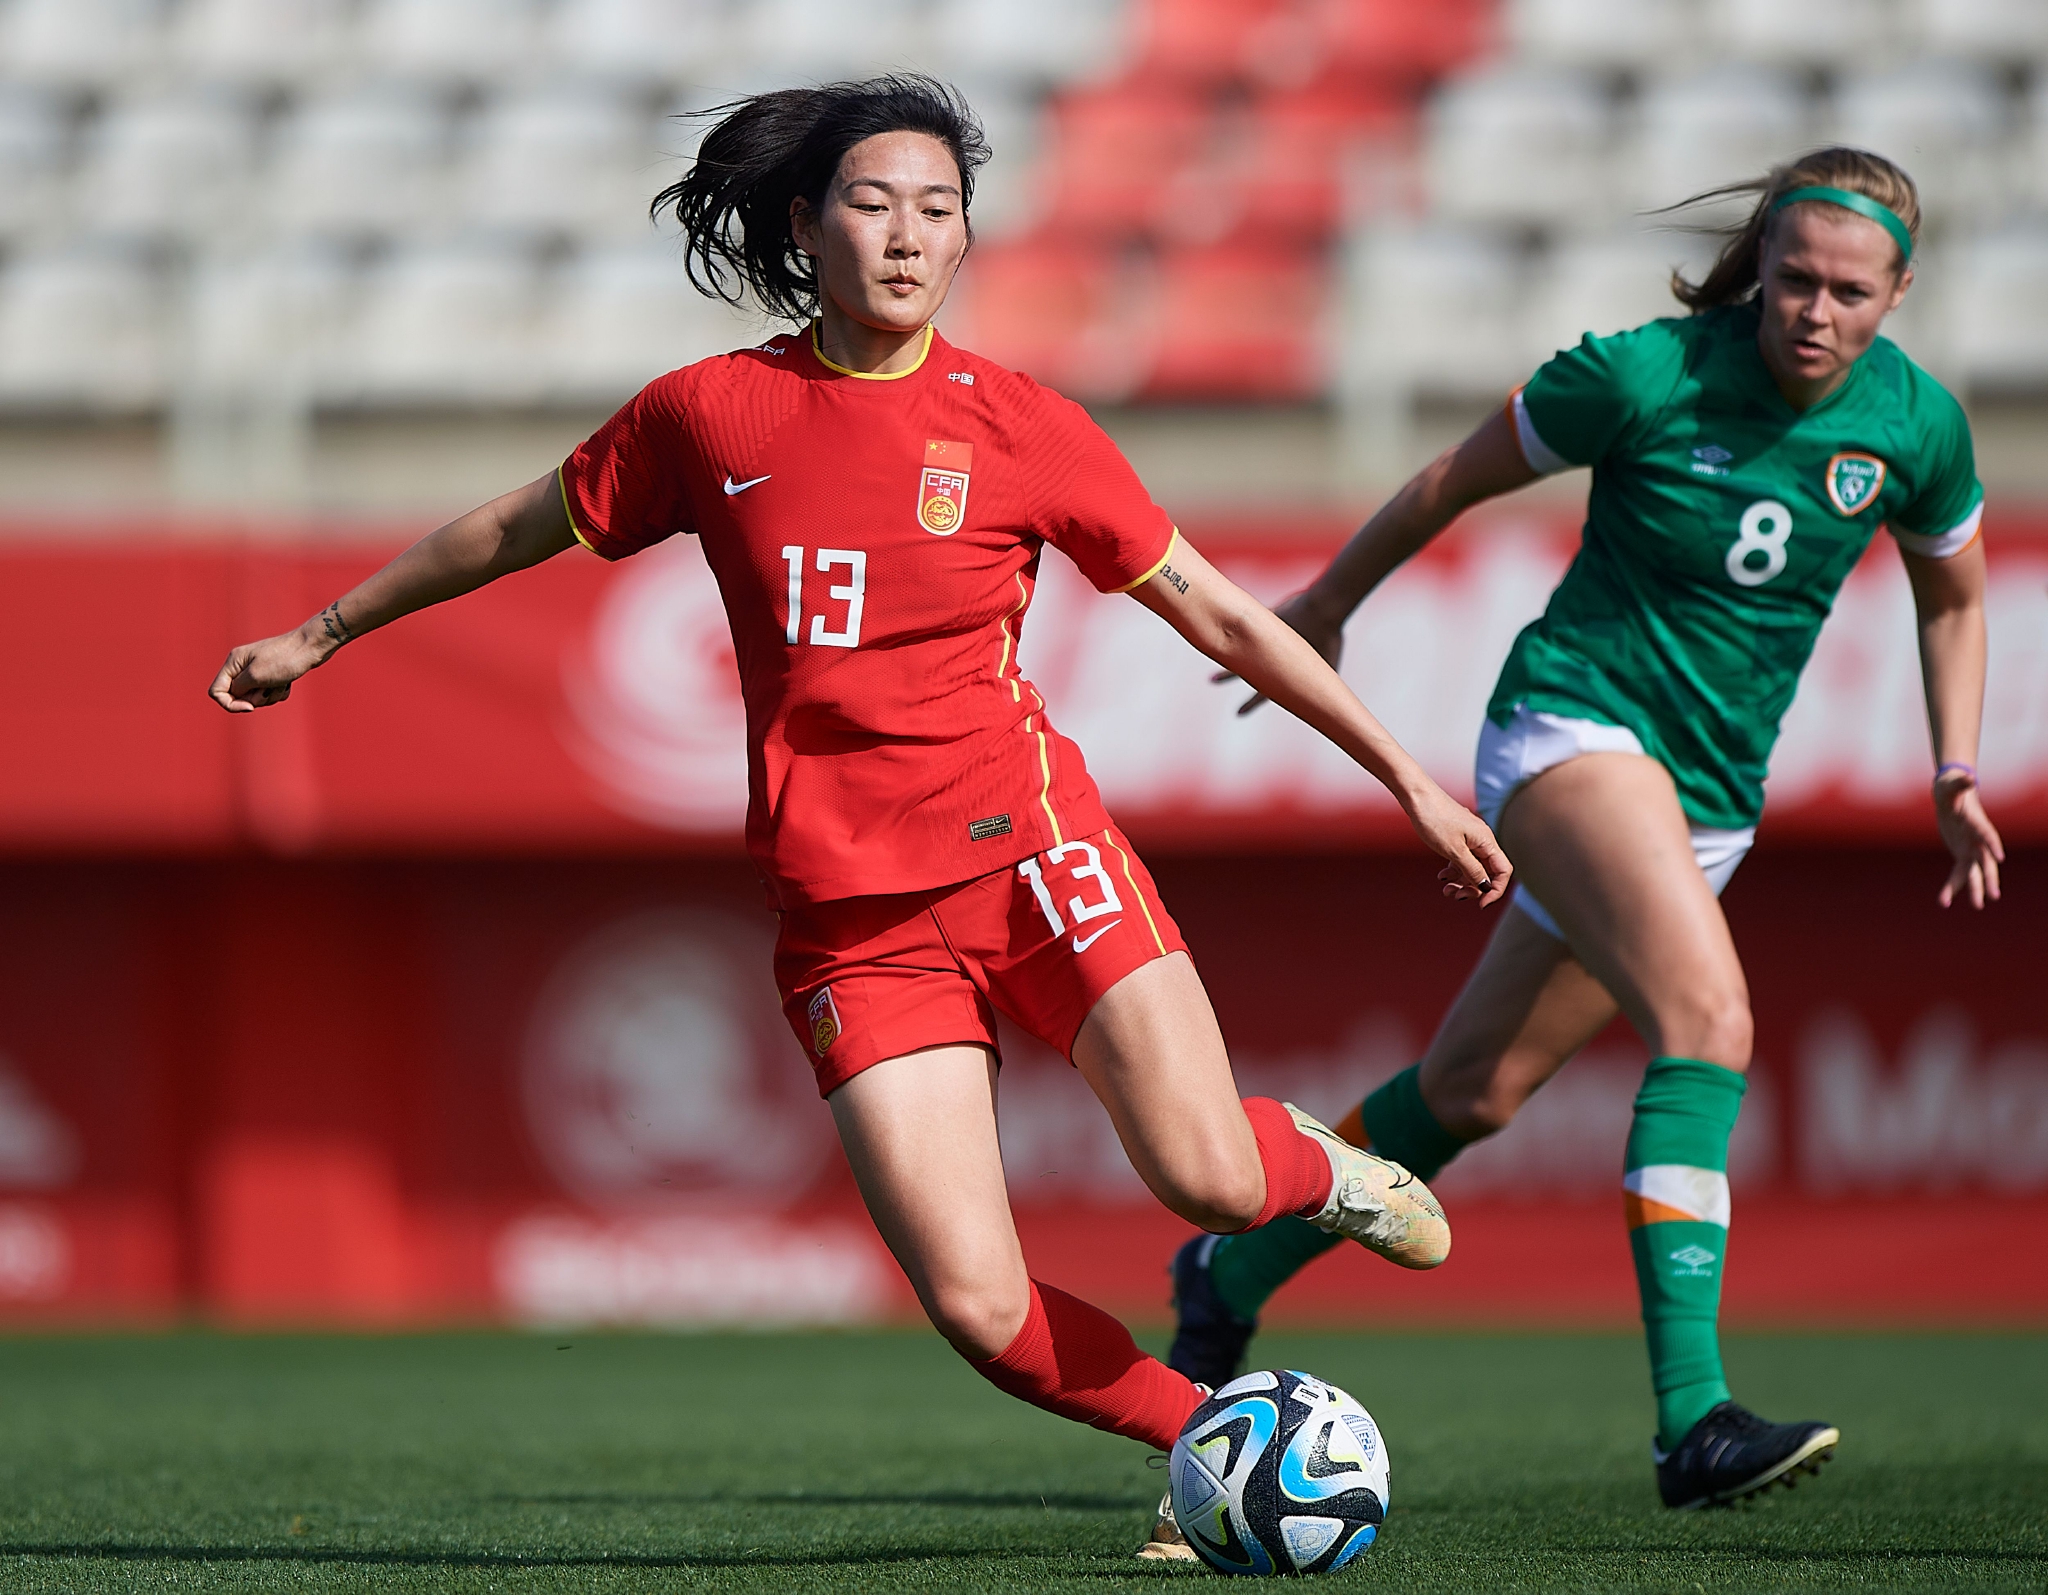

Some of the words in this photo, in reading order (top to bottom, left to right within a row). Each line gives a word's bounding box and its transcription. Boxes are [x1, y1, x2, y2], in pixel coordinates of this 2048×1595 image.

[947, 372, 975, 386] 中国
[926, 474, 963, 491] CFA
[1725, 499, 1793, 587] 8
[781, 545, 867, 648] 13
[1018, 840, 1123, 939] 13
